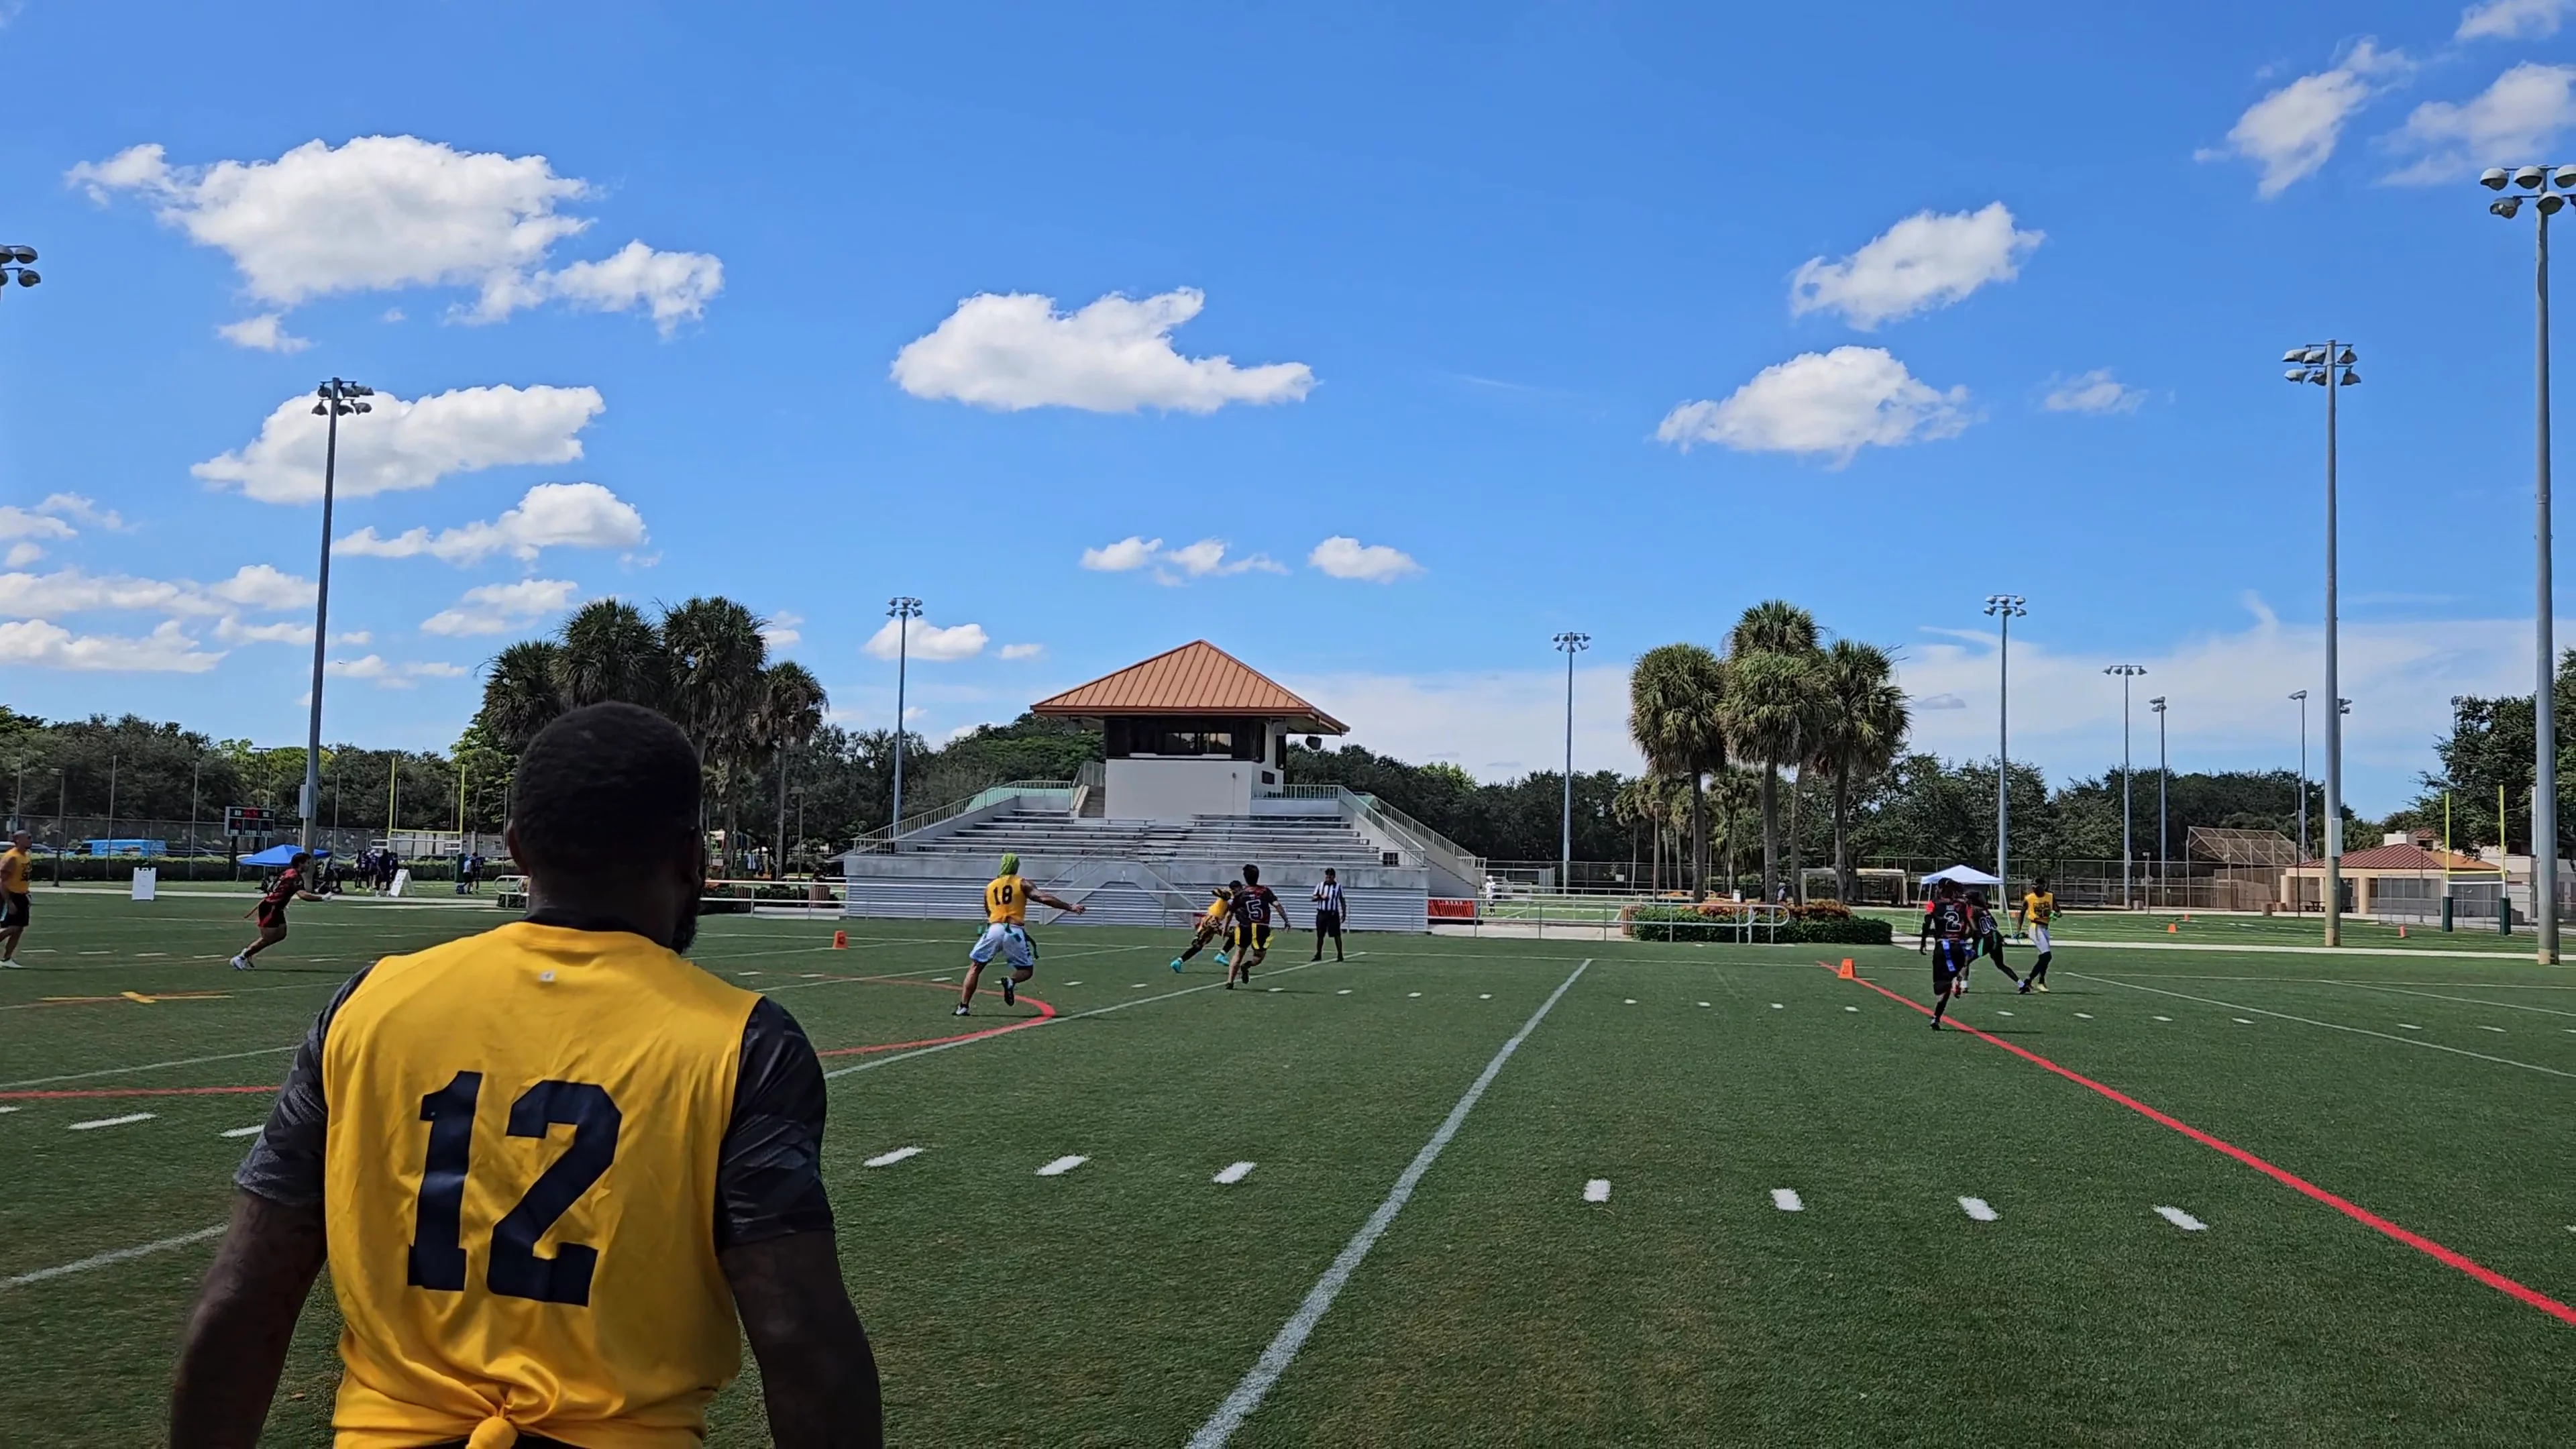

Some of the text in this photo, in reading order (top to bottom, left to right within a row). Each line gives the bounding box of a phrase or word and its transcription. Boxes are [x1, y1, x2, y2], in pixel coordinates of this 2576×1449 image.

[994, 885, 1013, 906] 18
[1246, 899, 1263, 922] 5
[1943, 911, 1962, 932] 2
[407, 1070, 623, 1307] 12
